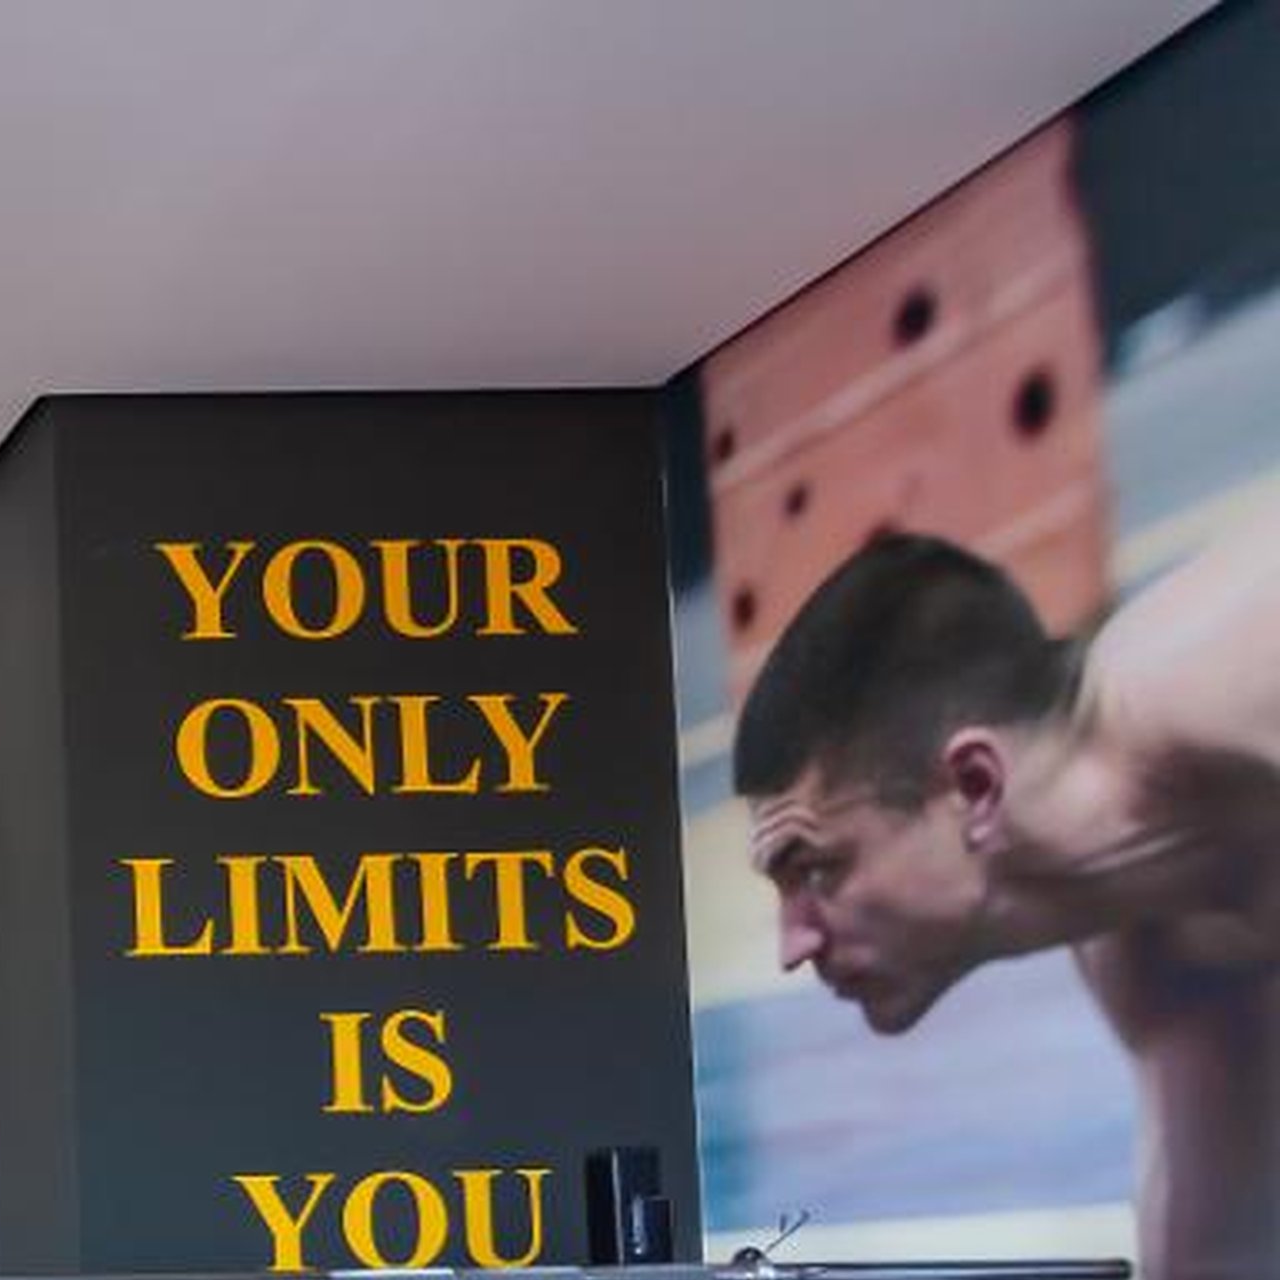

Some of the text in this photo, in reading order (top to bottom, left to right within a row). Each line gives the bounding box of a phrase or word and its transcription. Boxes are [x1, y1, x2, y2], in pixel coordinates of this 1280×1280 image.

[155, 538, 579, 641] YOUR
[175, 692, 569, 799] ONLY
[121, 846, 637, 957] LIMITS
[319, 1009, 453, 1114] IS
[231, 1168, 552, 1271] YOU
